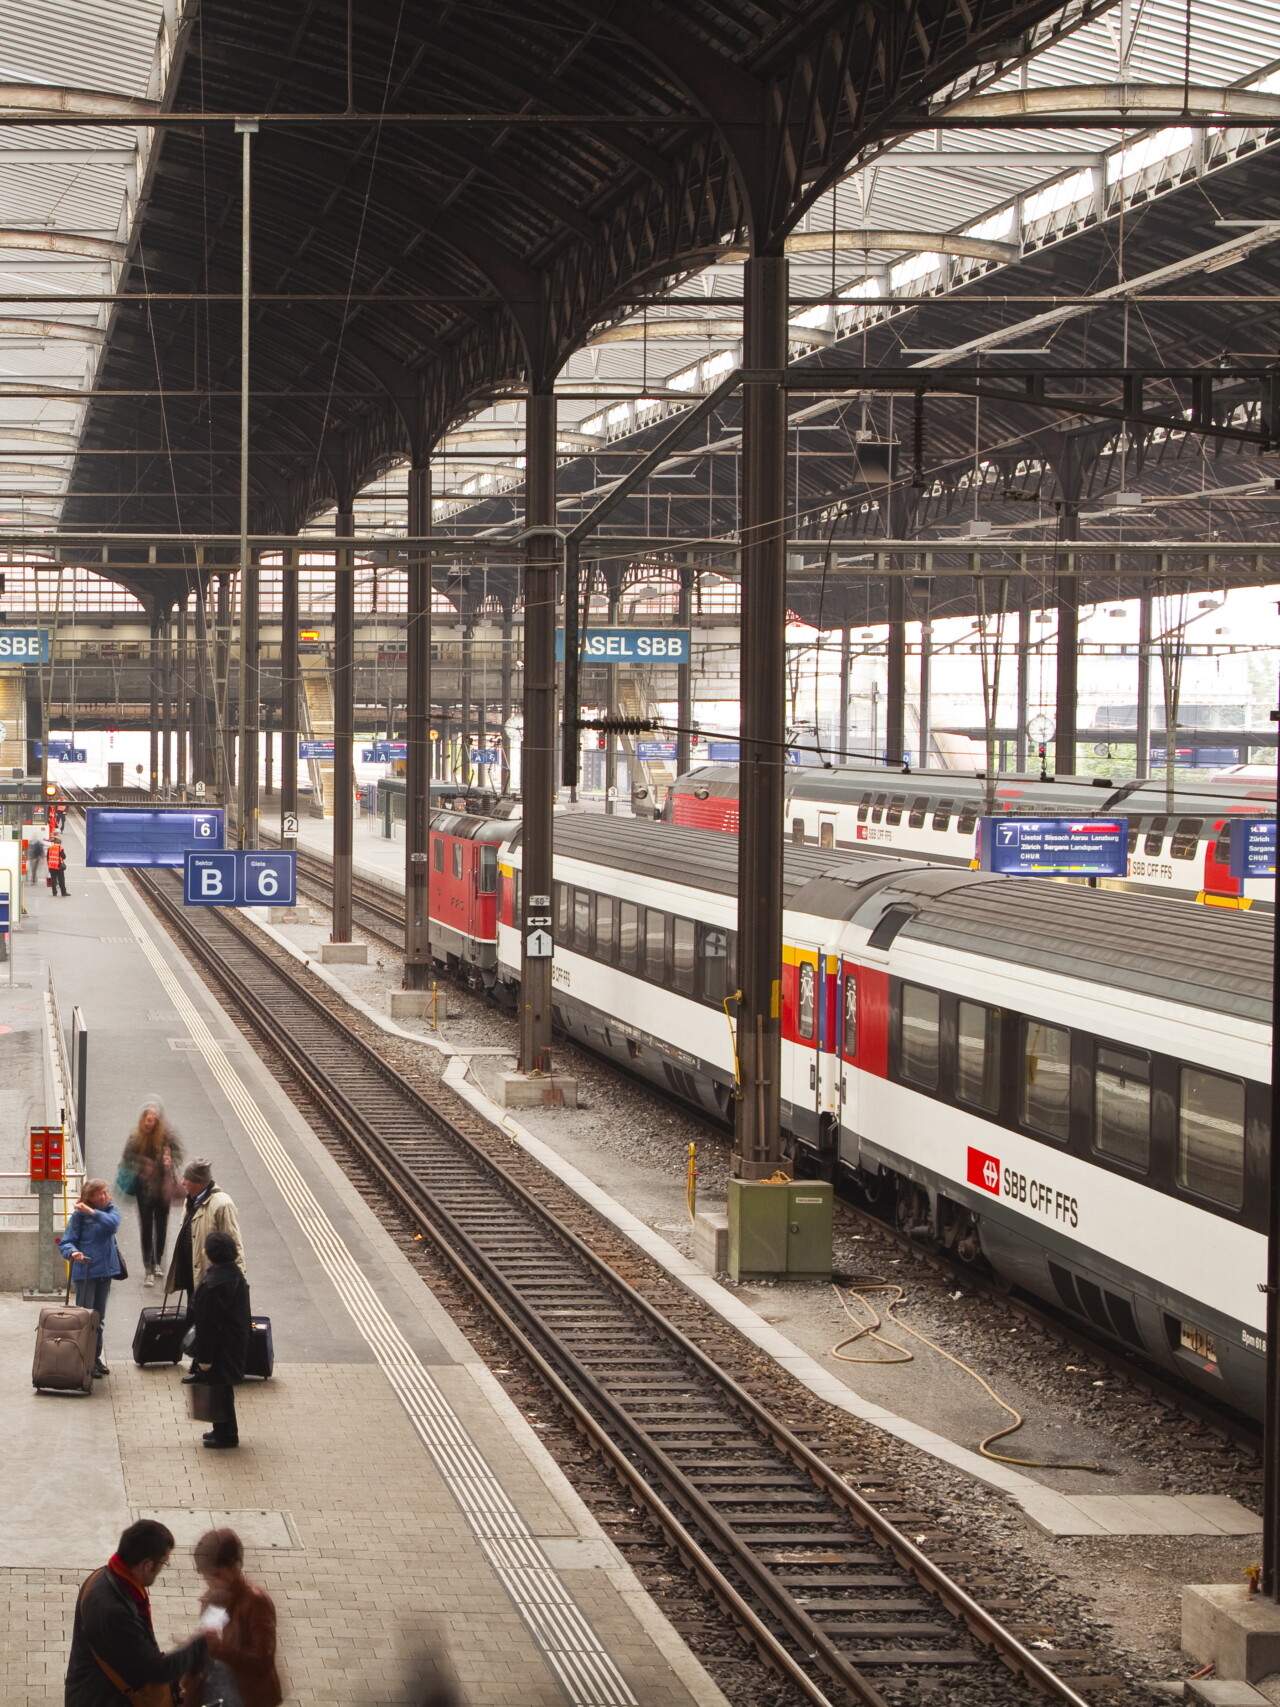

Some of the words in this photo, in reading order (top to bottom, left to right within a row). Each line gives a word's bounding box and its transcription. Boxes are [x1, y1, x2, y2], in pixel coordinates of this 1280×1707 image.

[577, 636, 634, 656] ASEL
[637, 637, 683, 656] SBB
[62, 752, 69, 760] A
[77, 752, 83, 760] 6
[366, 753, 372, 761] 7
[379, 754, 386, 762] A
[789, 755, 796, 763] A
[197, 783, 204, 791] 3
[610, 788, 616, 796] 3
[200, 823, 211, 837] 6
[286, 819, 294, 830] 2
[1002, 831, 1013, 844] 7
[1091, 834, 1119, 842] Lenzburg
[1043, 844, 1070, 852] Sargans
[1071, 844, 1103, 852] Landquart
[1248, 845, 1275, 853] Sargans
[1132, 860, 1146, 876] SBB
[1146, 863, 1159, 878] CFF
[1160, 864, 1173, 880] FFS
[201, 868, 223, 896] B
[258, 869, 279, 897] 6
[535, 897, 544, 905] 60
[535, 934, 542, 955] 1
[821, 959, 826, 983] 1
[837, 958, 842, 985] 2
[1003, 1167, 1027, 1203] SBB
[1029, 1180, 1053, 1214] CFF
[1055, 1191, 1079, 1228] FFS
[1241, 1329, 1255, 1347] Bpm
